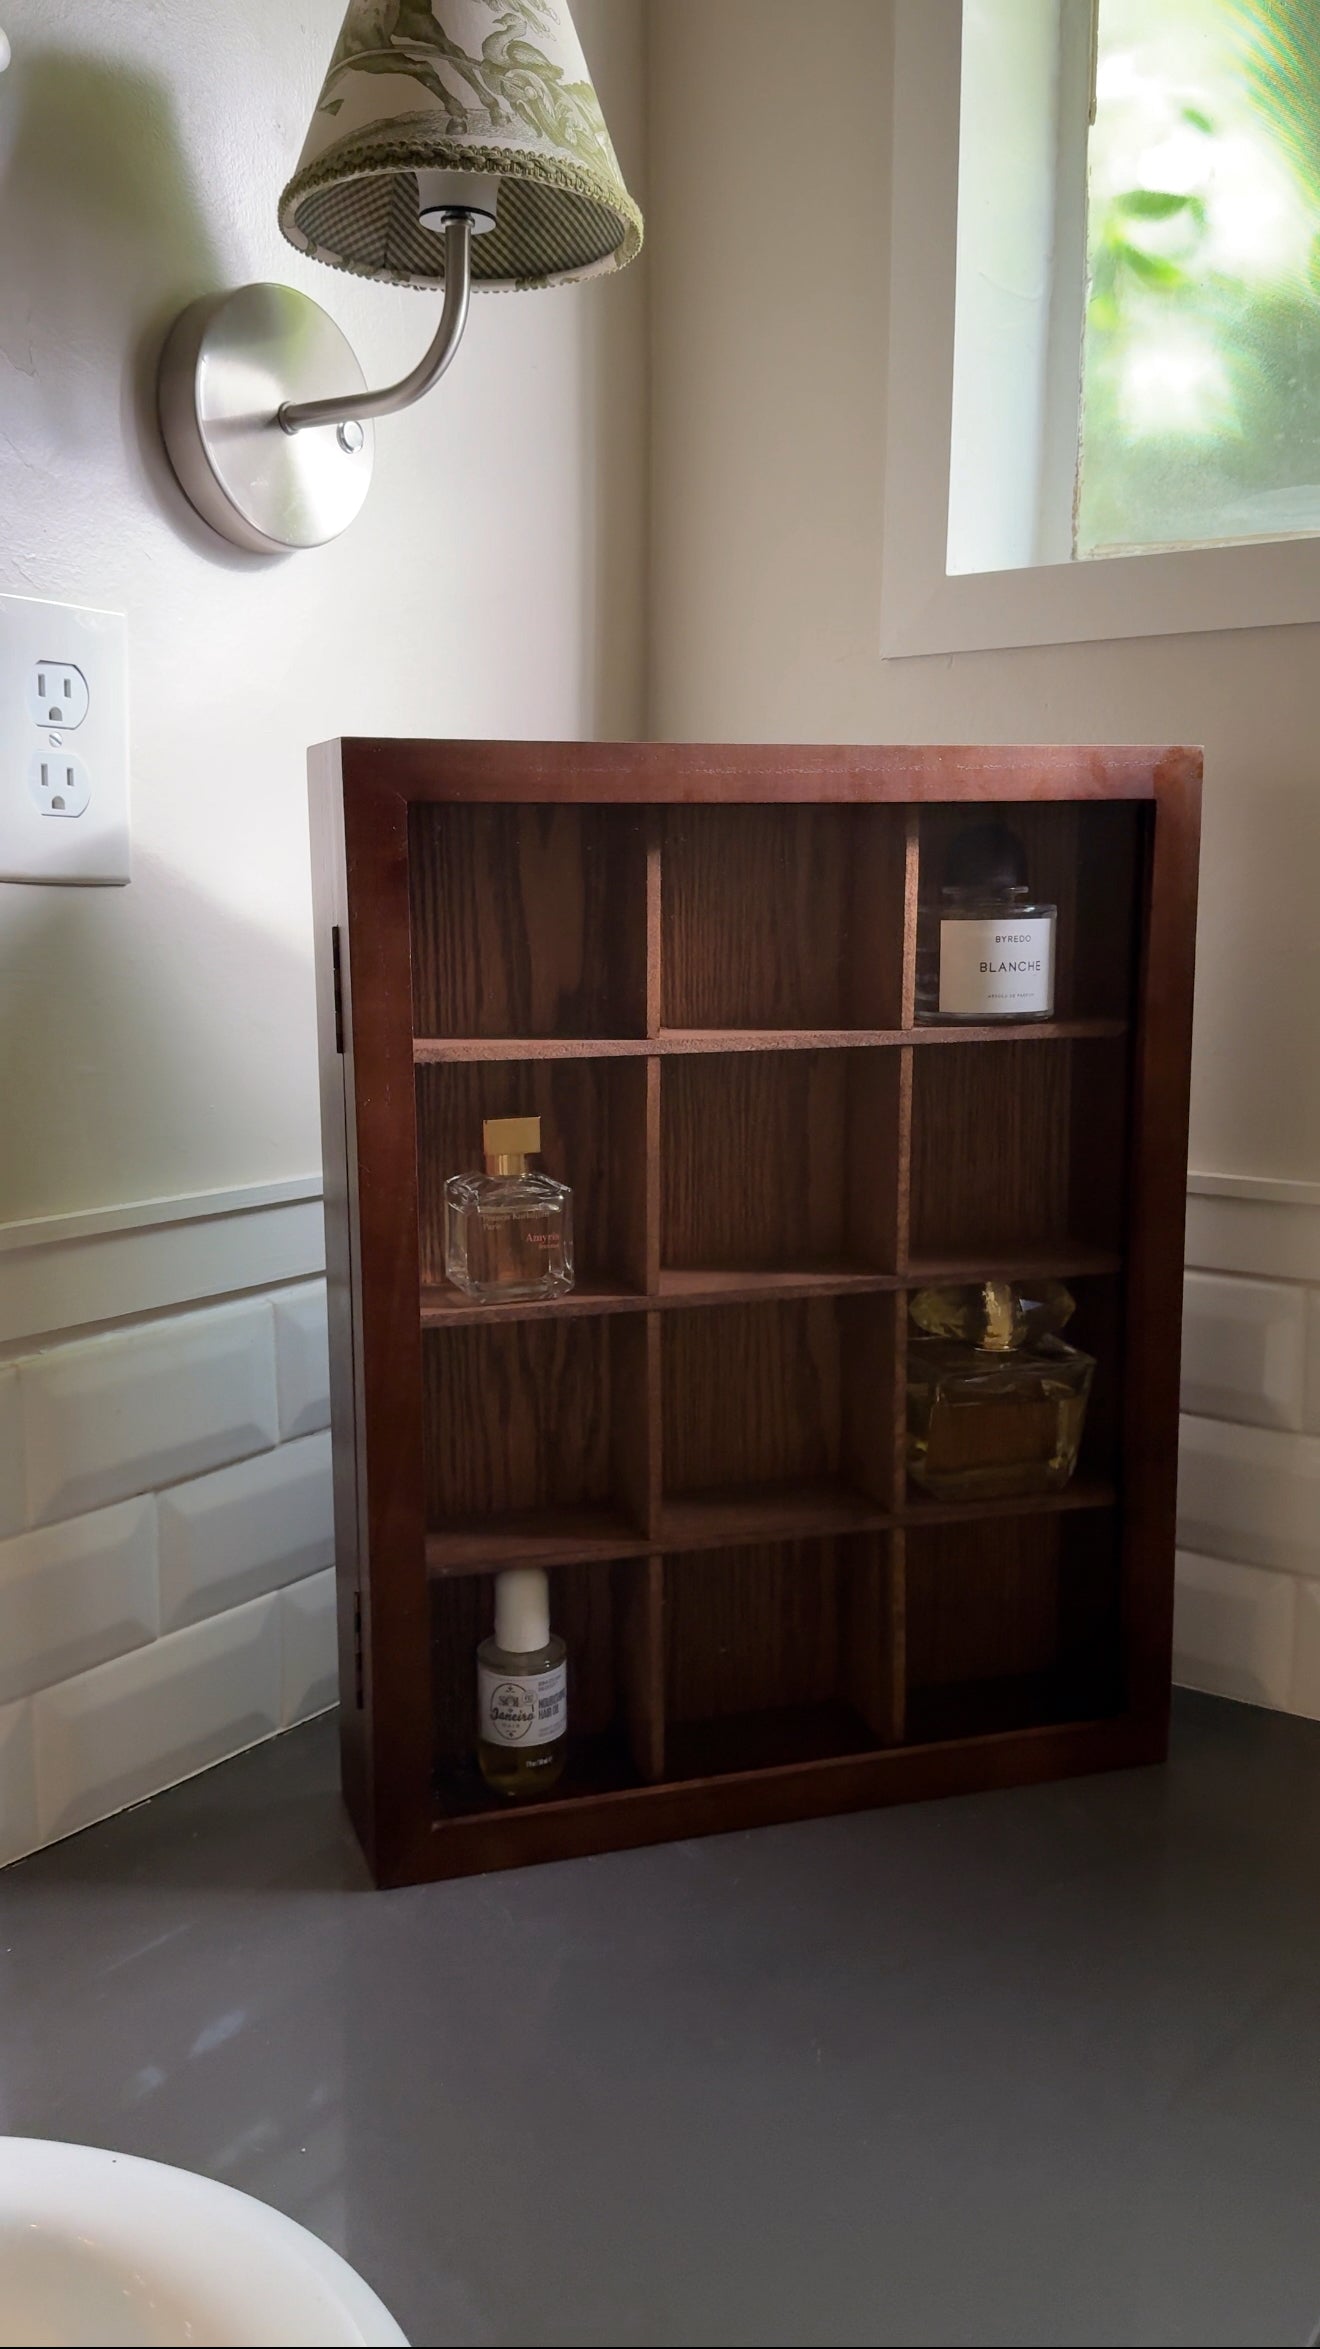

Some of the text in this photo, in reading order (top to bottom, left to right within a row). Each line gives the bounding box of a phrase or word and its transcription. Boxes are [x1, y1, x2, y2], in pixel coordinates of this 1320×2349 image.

[995, 935, 1032, 943] BYREDO
[979, 961, 1041, 973] BLANCHE
[490, 1707, 535, 1722] Janeiro
